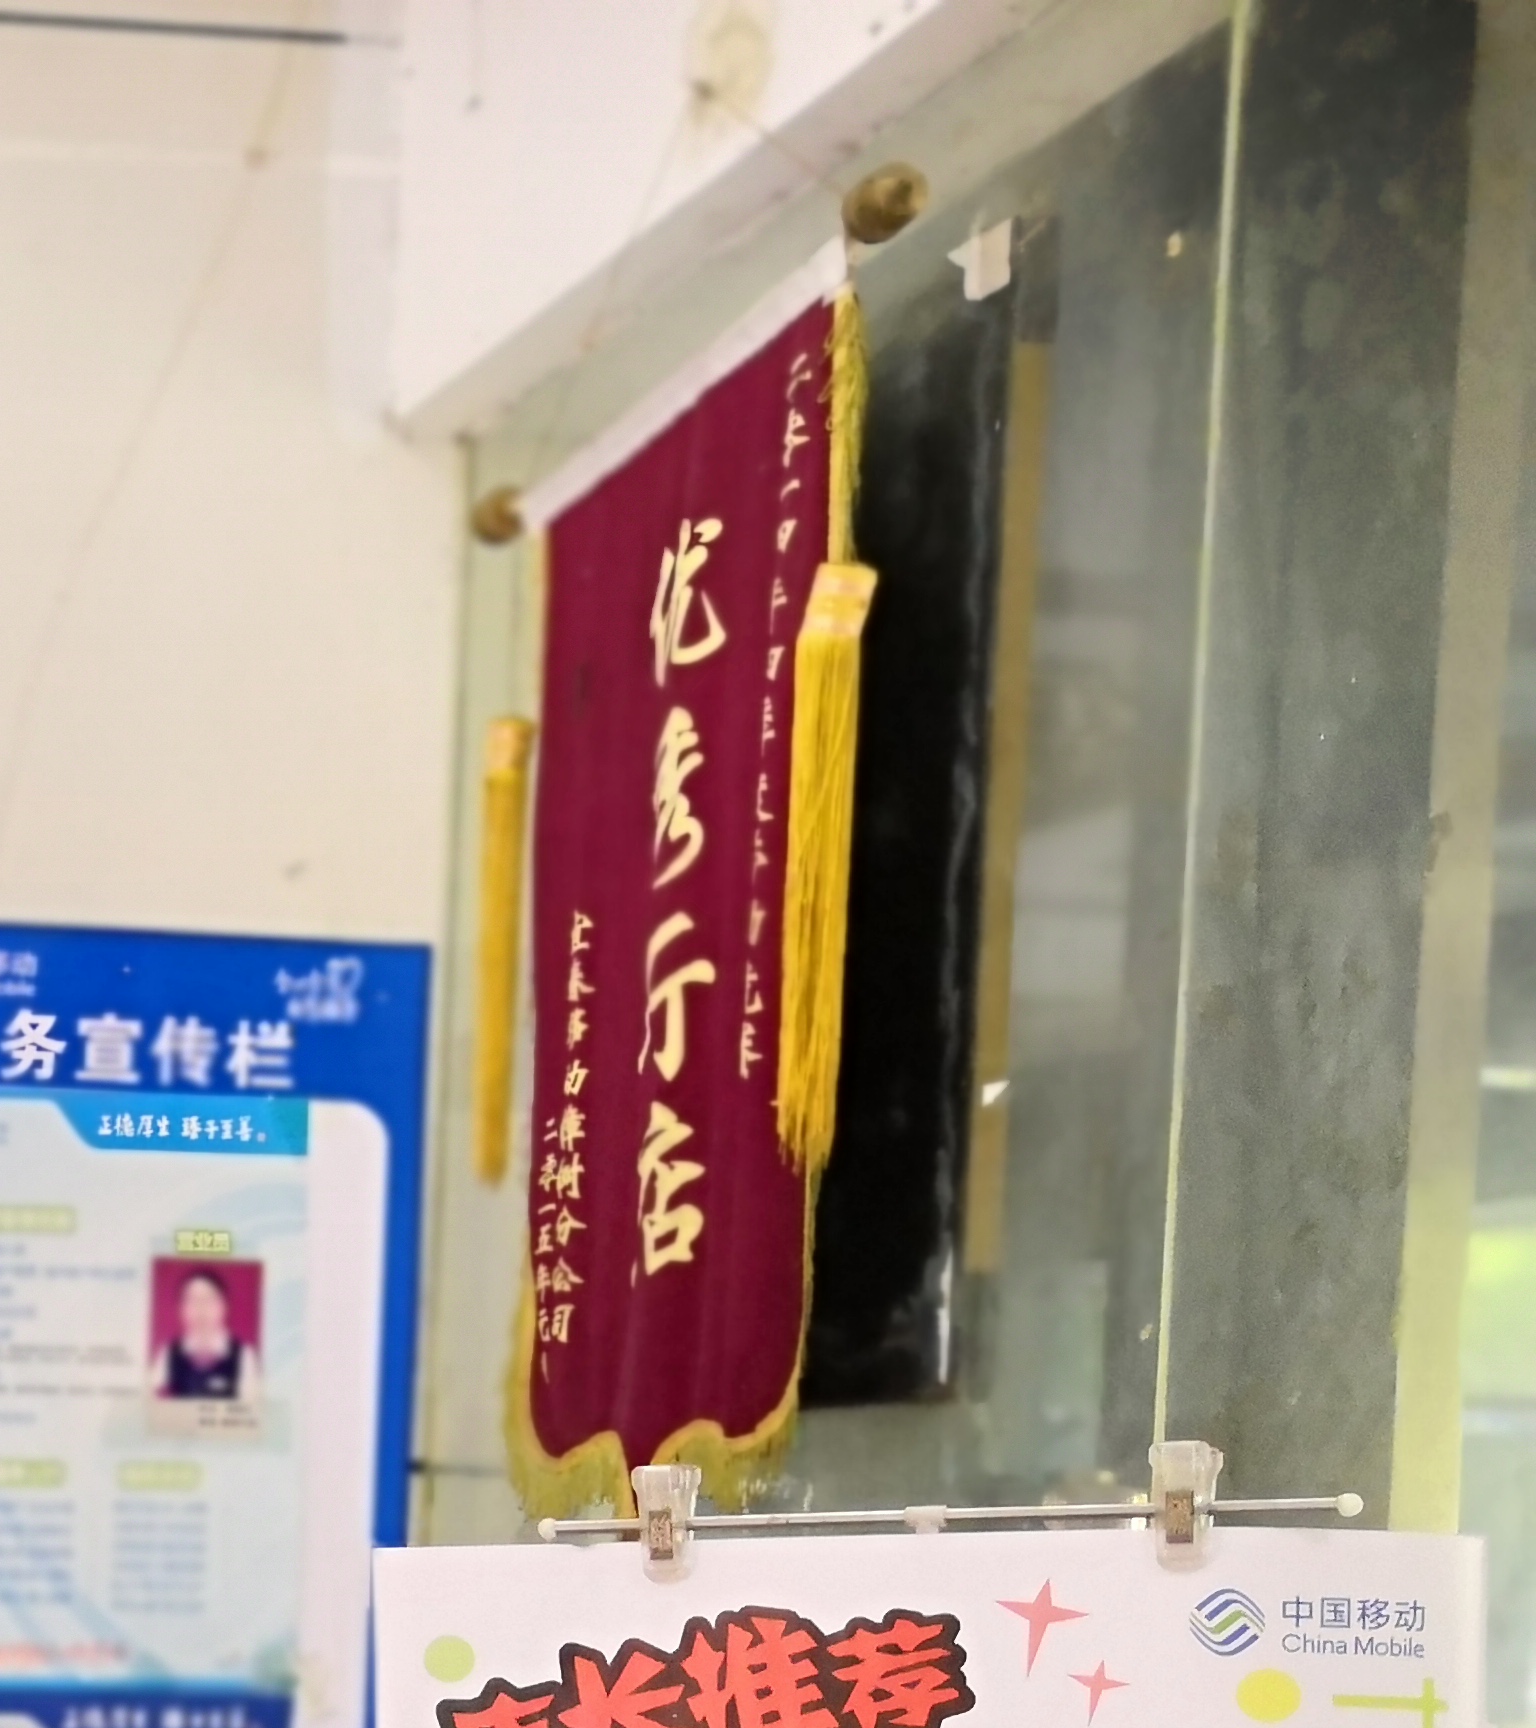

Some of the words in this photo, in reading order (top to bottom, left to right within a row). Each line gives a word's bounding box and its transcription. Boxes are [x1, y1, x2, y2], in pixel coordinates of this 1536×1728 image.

[631, 517, 728, 1288] 优秀厅店
[1282, 1596, 1426, 1632] 中国移动
[1281, 1633, 1348, 1655] China
[1354, 1636, 1425, 1659] Mobile
